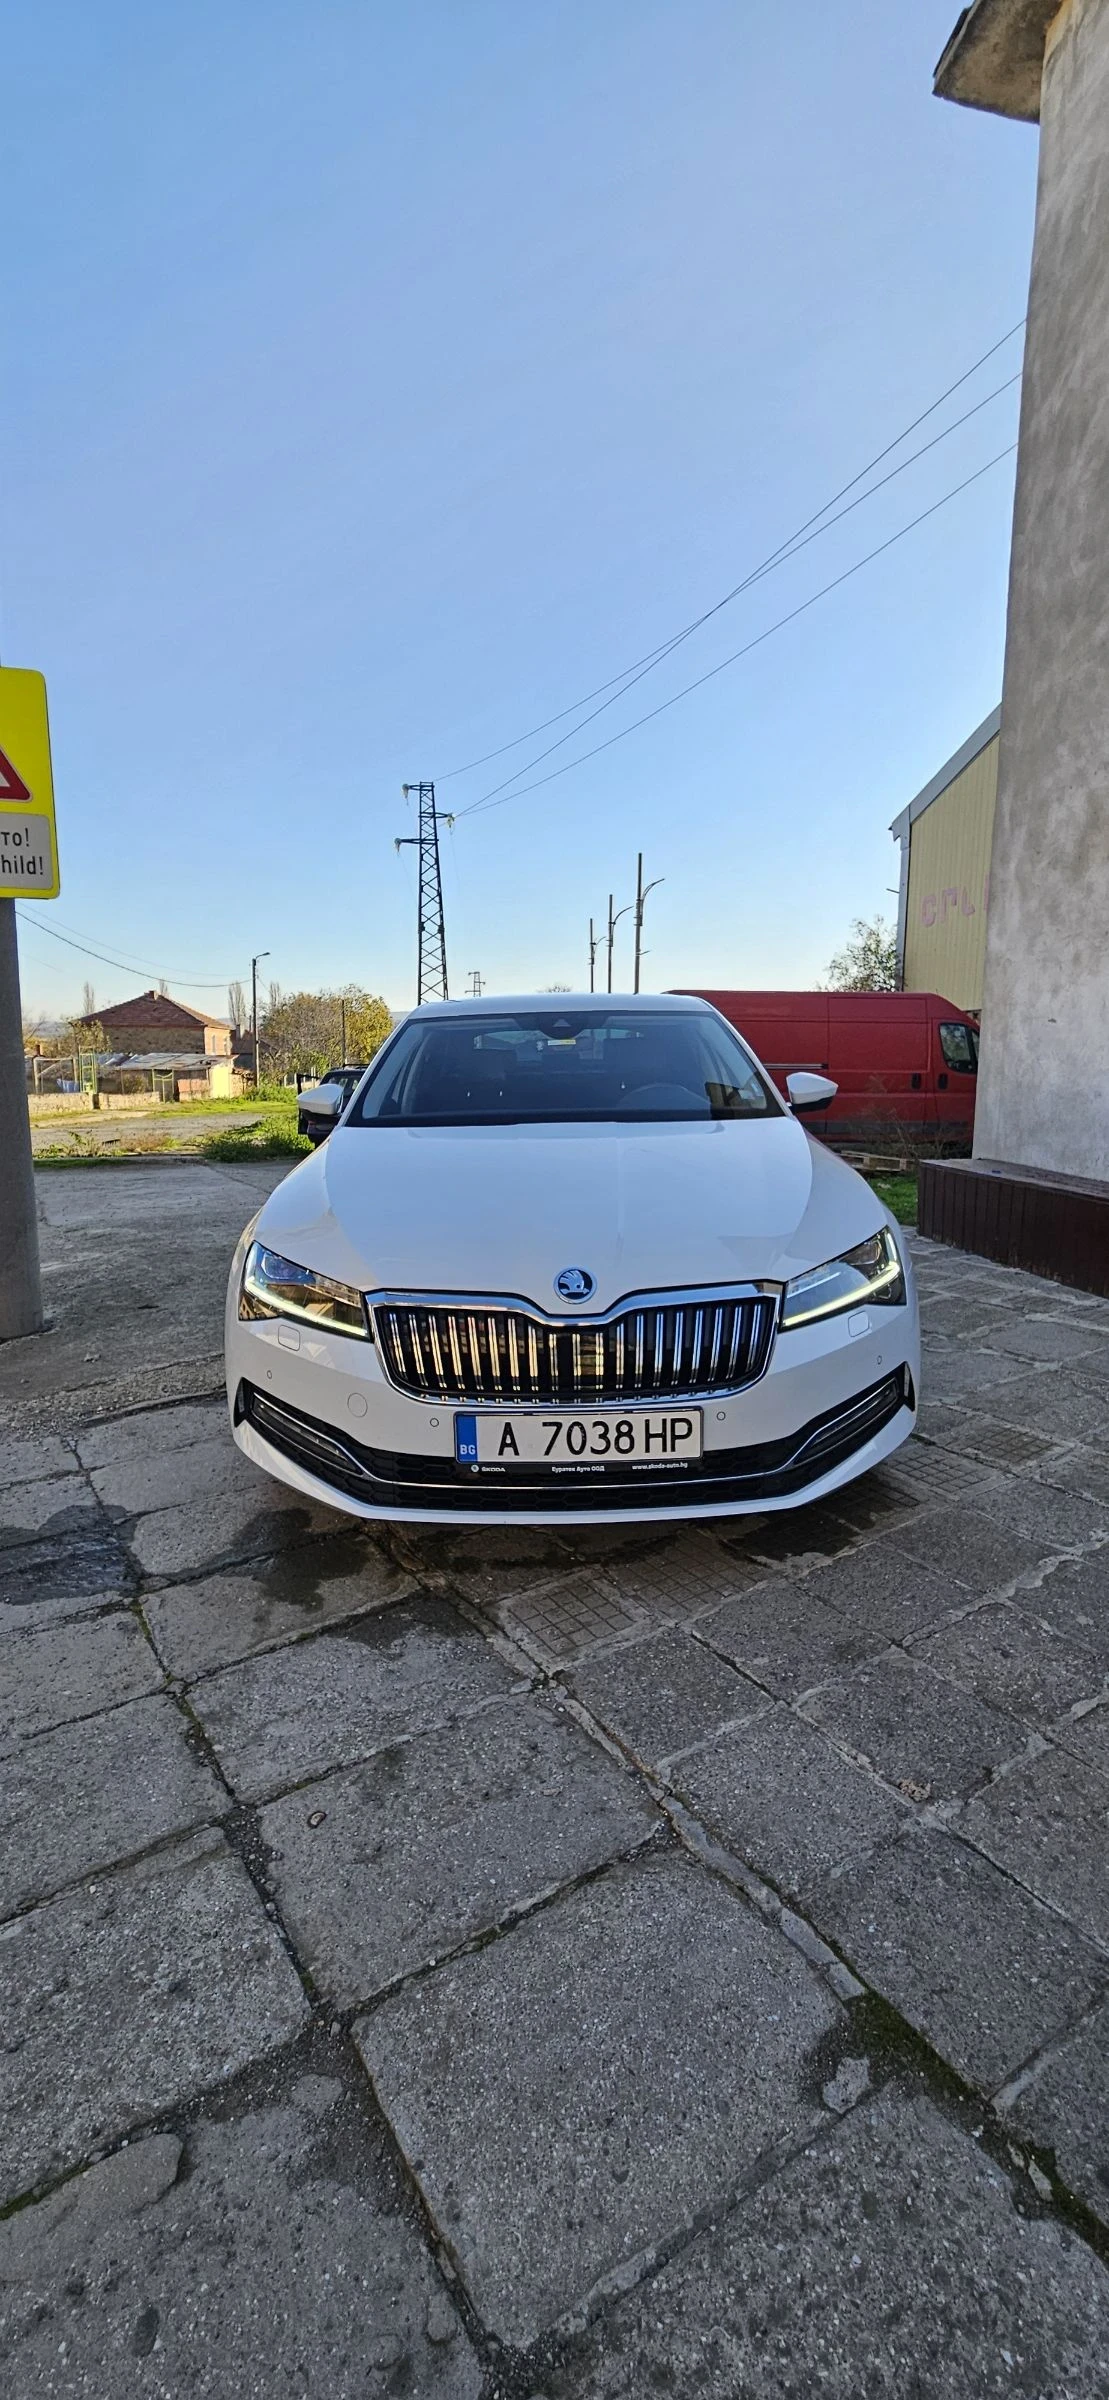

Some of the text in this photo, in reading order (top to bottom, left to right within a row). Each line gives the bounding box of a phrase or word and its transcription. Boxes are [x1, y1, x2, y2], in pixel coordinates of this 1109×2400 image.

[0, 827, 29, 847] то!
[0, 854, 43, 875] hild!
[498, 1418, 694, 1456] A 7038 HP
[460, 1444, 476, 1455] BG
[632, 1462, 688, 1470] www.skoda-auto.bg
